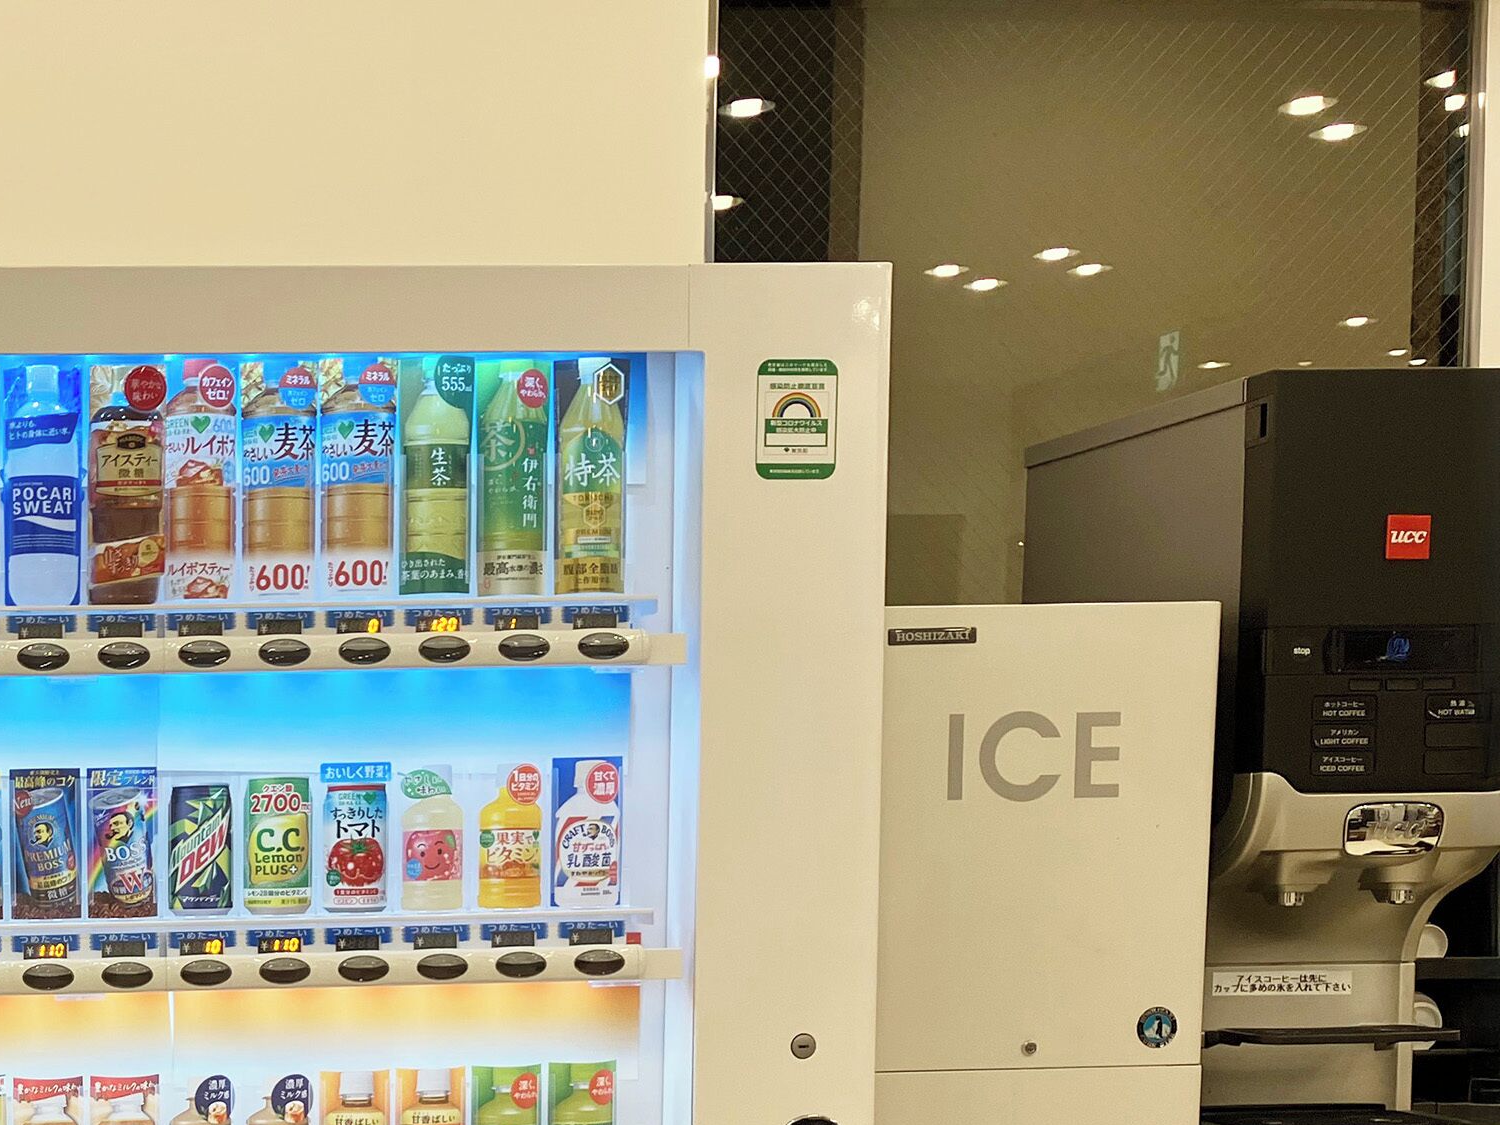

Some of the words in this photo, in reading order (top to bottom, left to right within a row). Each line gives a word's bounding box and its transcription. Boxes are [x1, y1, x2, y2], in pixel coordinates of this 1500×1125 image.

[202, 376, 233, 388] カフェイン
[285, 375, 310, 385] ミネラル
[101, 453, 158, 467] アイスティー
[119, 468, 144, 478] 微糖
[430, 448, 451, 486] 生茶
[564, 453, 620, 487] 特茶
[13, 487, 76, 501] POCARI
[522, 458, 538, 528] 伊右衛門
[13, 501, 72, 515] SWEAT
[895, 629, 970, 642] HOSHIZAKI
[1293, 646, 1311, 656] stop
[946, 710, 1122, 802] ICE
[15, 776, 75, 788] 最高峰のコク
[594, 771, 615, 781] 甘くて
[593, 782, 615, 795] 濃厚
[330, 808, 383, 820] すっきりした
[337, 820, 380, 839] トマト
[256, 828, 305, 851] C.C.
[496, 831, 534, 845] 果実で
[562, 824, 585, 849] CRAFT
[255, 852, 302, 863] Lemon
[567, 853, 612, 868] 乳酸菌
[1236, 974, 1327, 983] アイスコーヒーは先に
[1214, 982, 1351, 993] カップに多めの氷を入れて下さい
